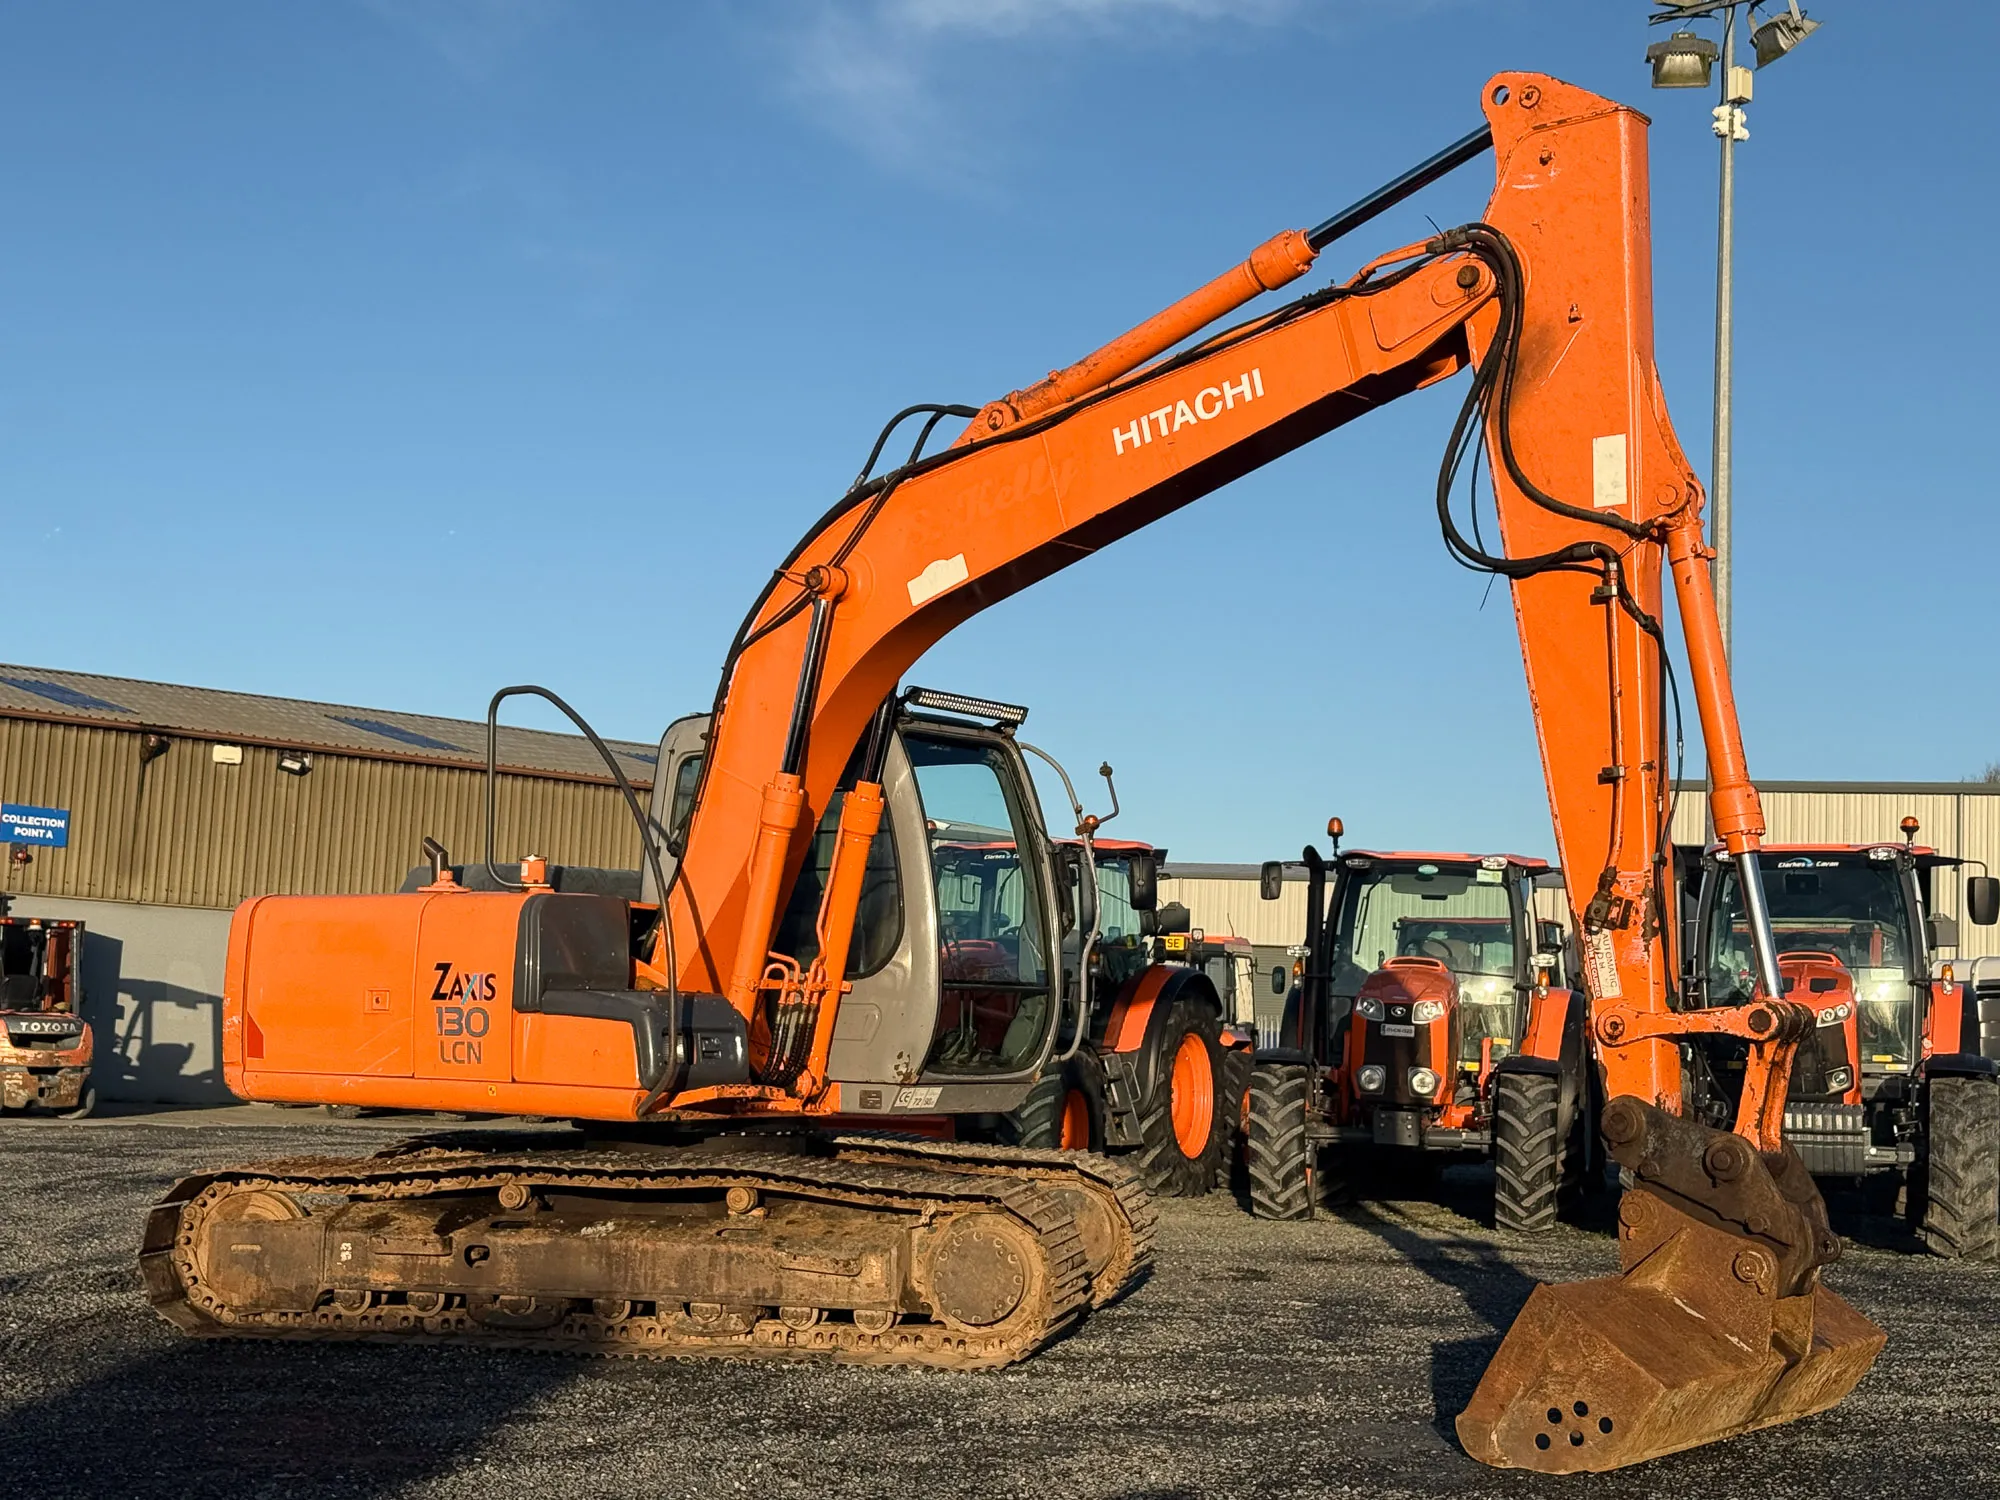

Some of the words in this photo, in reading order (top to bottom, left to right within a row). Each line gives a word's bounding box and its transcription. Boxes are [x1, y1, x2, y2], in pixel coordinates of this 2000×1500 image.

[1112, 367, 1265, 456] HITACHI
[2, 813, 65, 828] COLLECTION
[14, 827, 45, 838] POINT
[46, 829, 53, 839] A
[1602, 932, 1618, 988] AUTOMATIC
[20, 1021, 77, 1033] TOYOTA
[436, 1006, 490, 1037] 130
[440, 1039, 482, 1065] LCN
